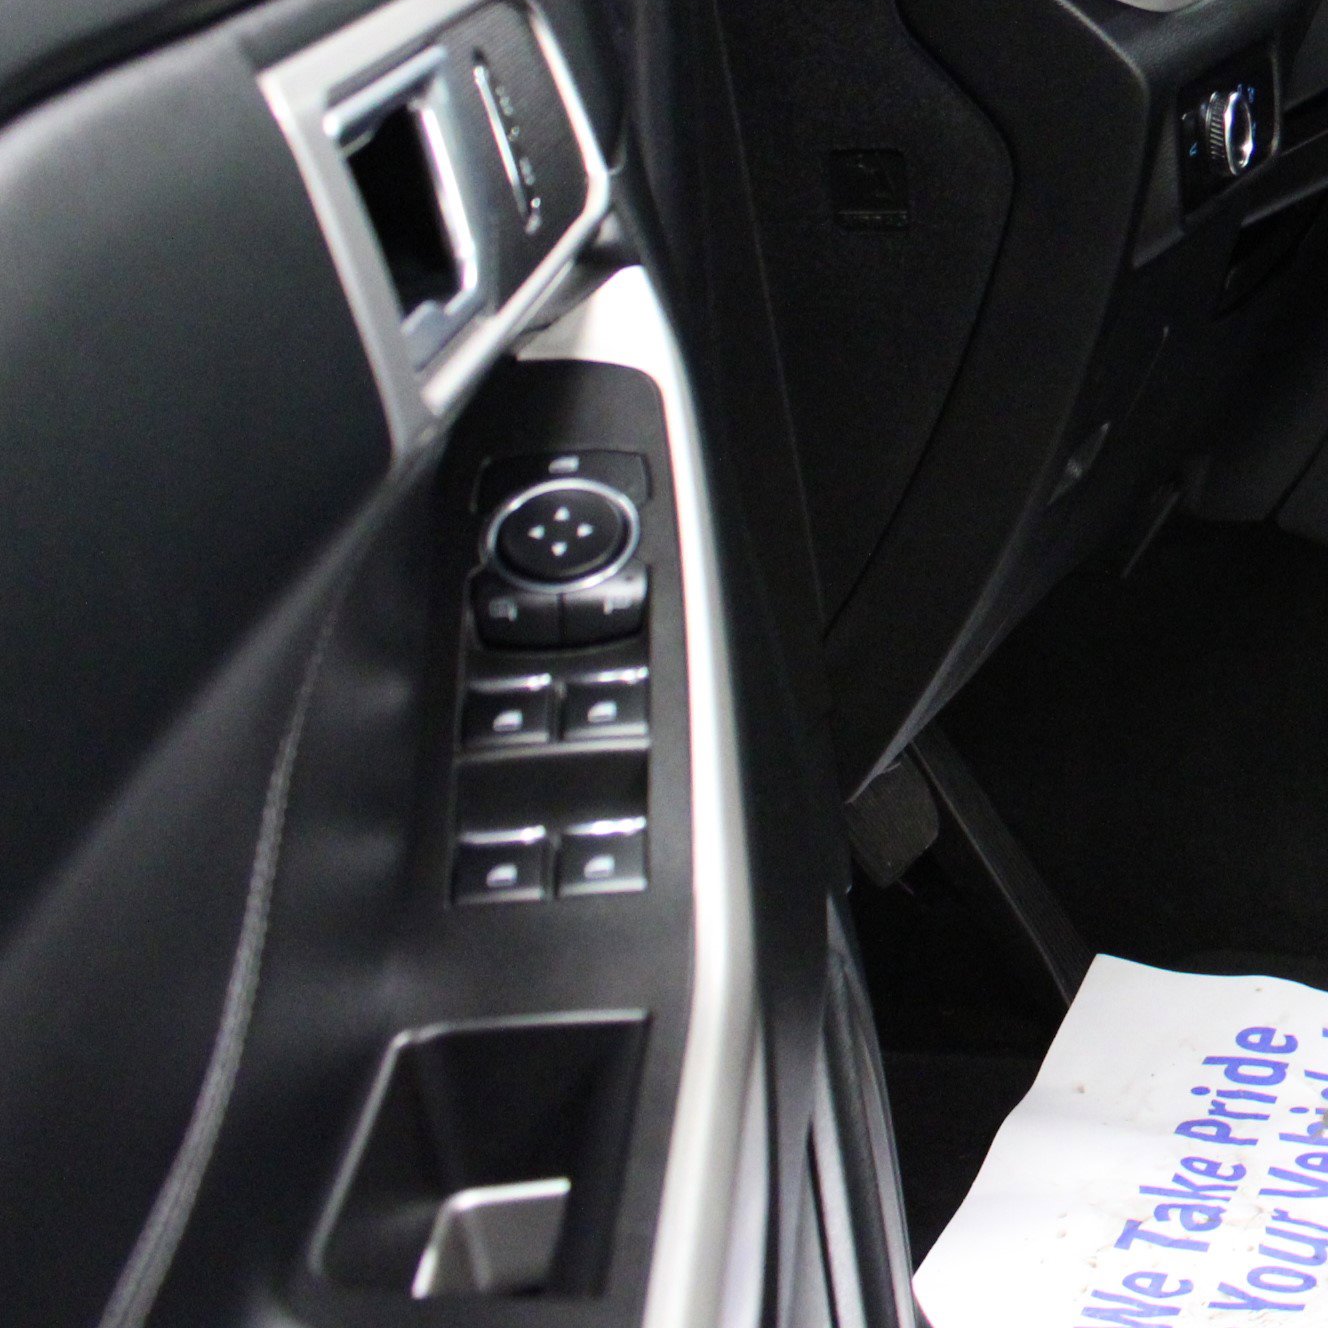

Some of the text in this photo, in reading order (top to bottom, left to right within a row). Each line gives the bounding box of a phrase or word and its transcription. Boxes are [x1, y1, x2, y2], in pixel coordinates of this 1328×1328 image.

[1072, 1026, 1299, 1328] We Take Pride
